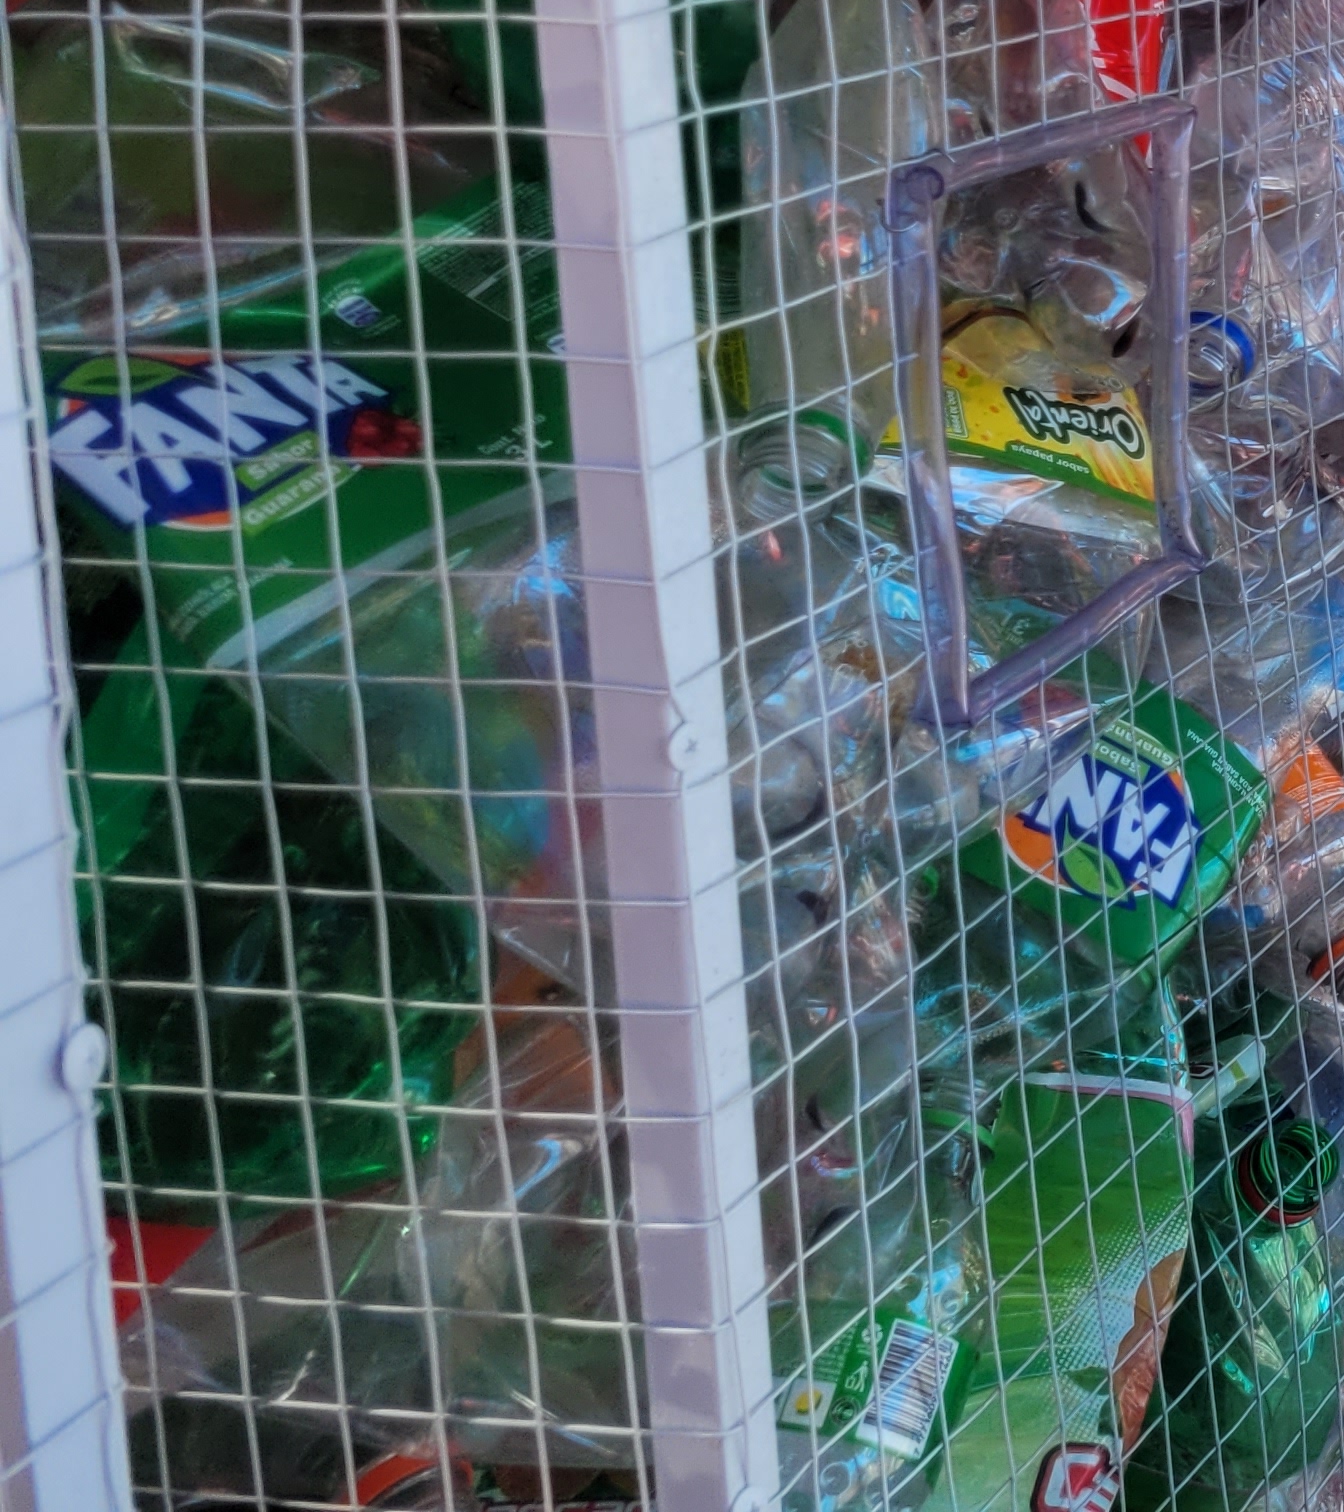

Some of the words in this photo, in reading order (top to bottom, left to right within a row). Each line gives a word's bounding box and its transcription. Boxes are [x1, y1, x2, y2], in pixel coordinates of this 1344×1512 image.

[51, 356, 389, 526] FANTA
[1010, 390, 1139, 453] Oriental
[1010, 443, 1054, 463] papaya
[1055, 458, 1090, 475] sabor
[1021, 755, 1198, 901] FAN
